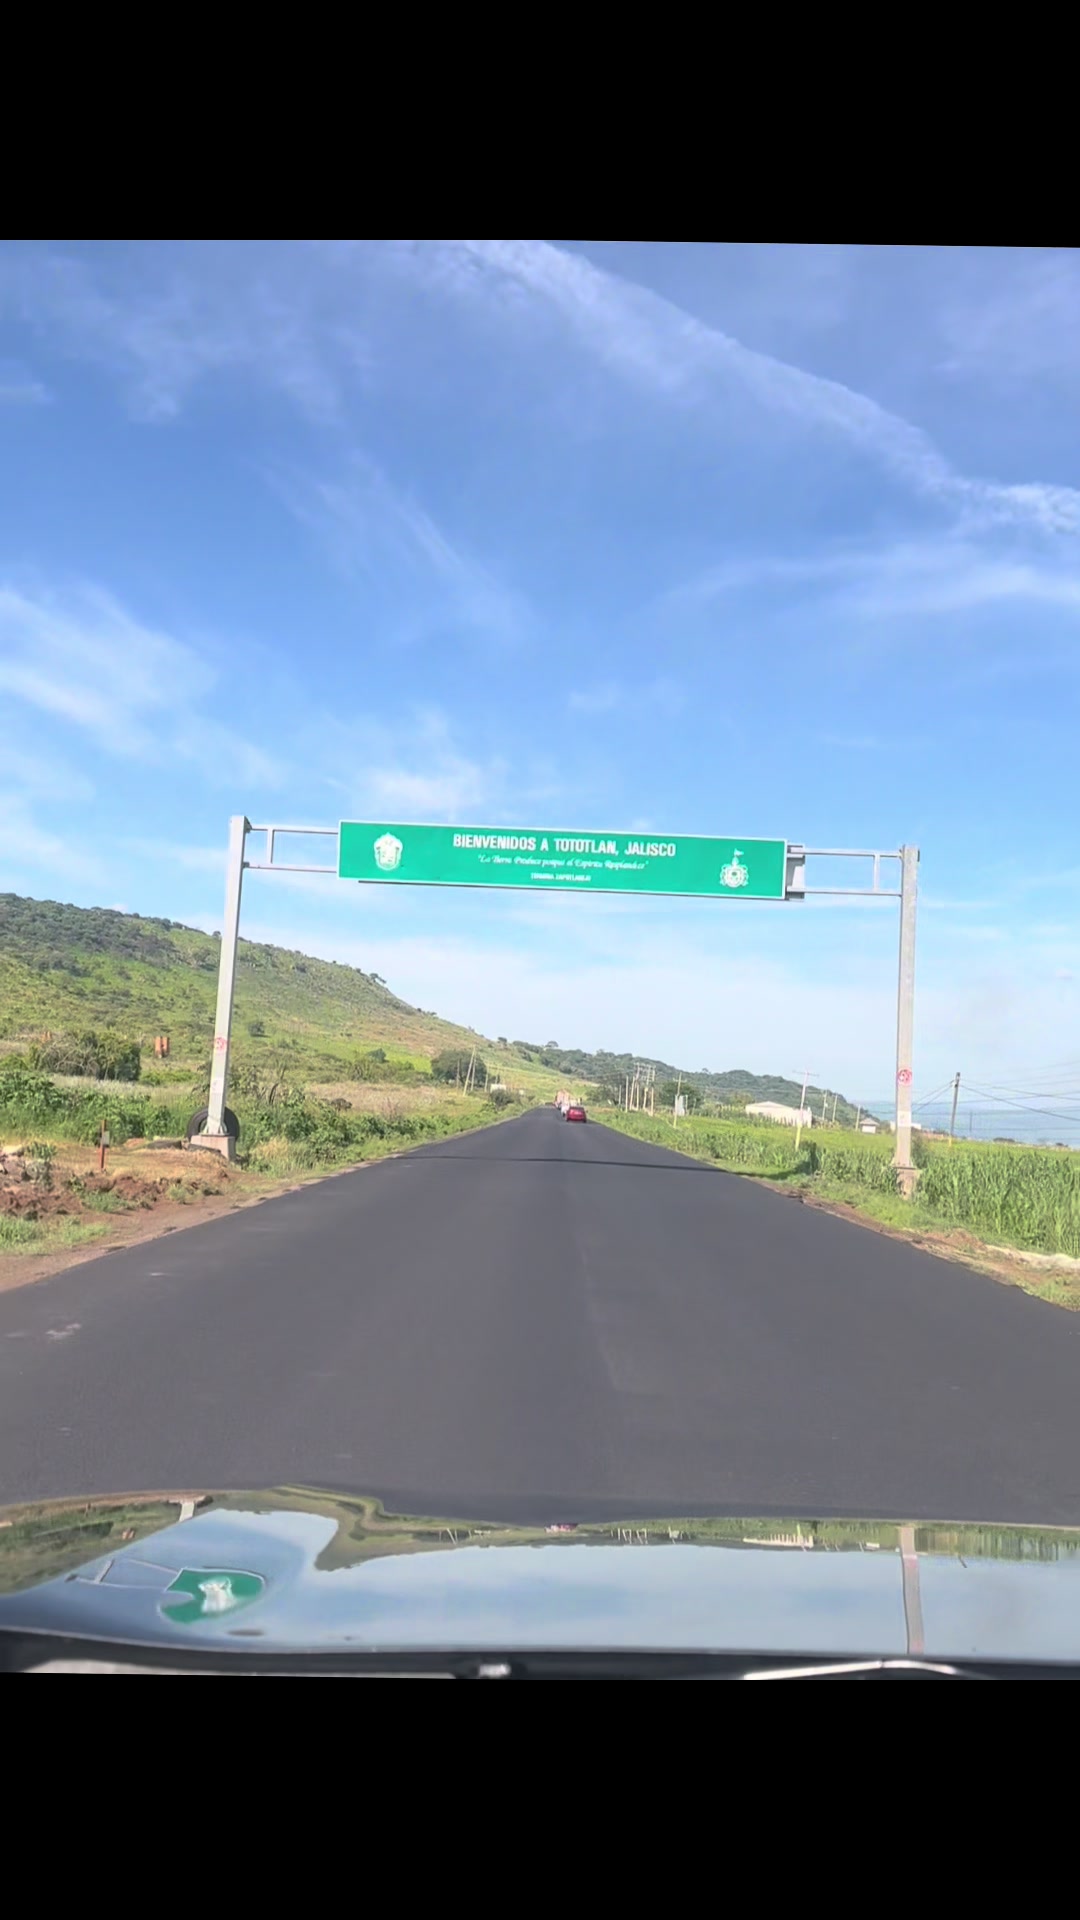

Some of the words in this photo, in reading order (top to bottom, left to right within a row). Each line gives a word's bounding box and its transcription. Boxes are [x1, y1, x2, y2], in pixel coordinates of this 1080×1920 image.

[453, 833, 536, 851] BIENVENIDOS
[540, 838, 549, 851] A
[554, 838, 619, 854] TOTOTLAN,
[624, 841, 676, 856] JALISCO
